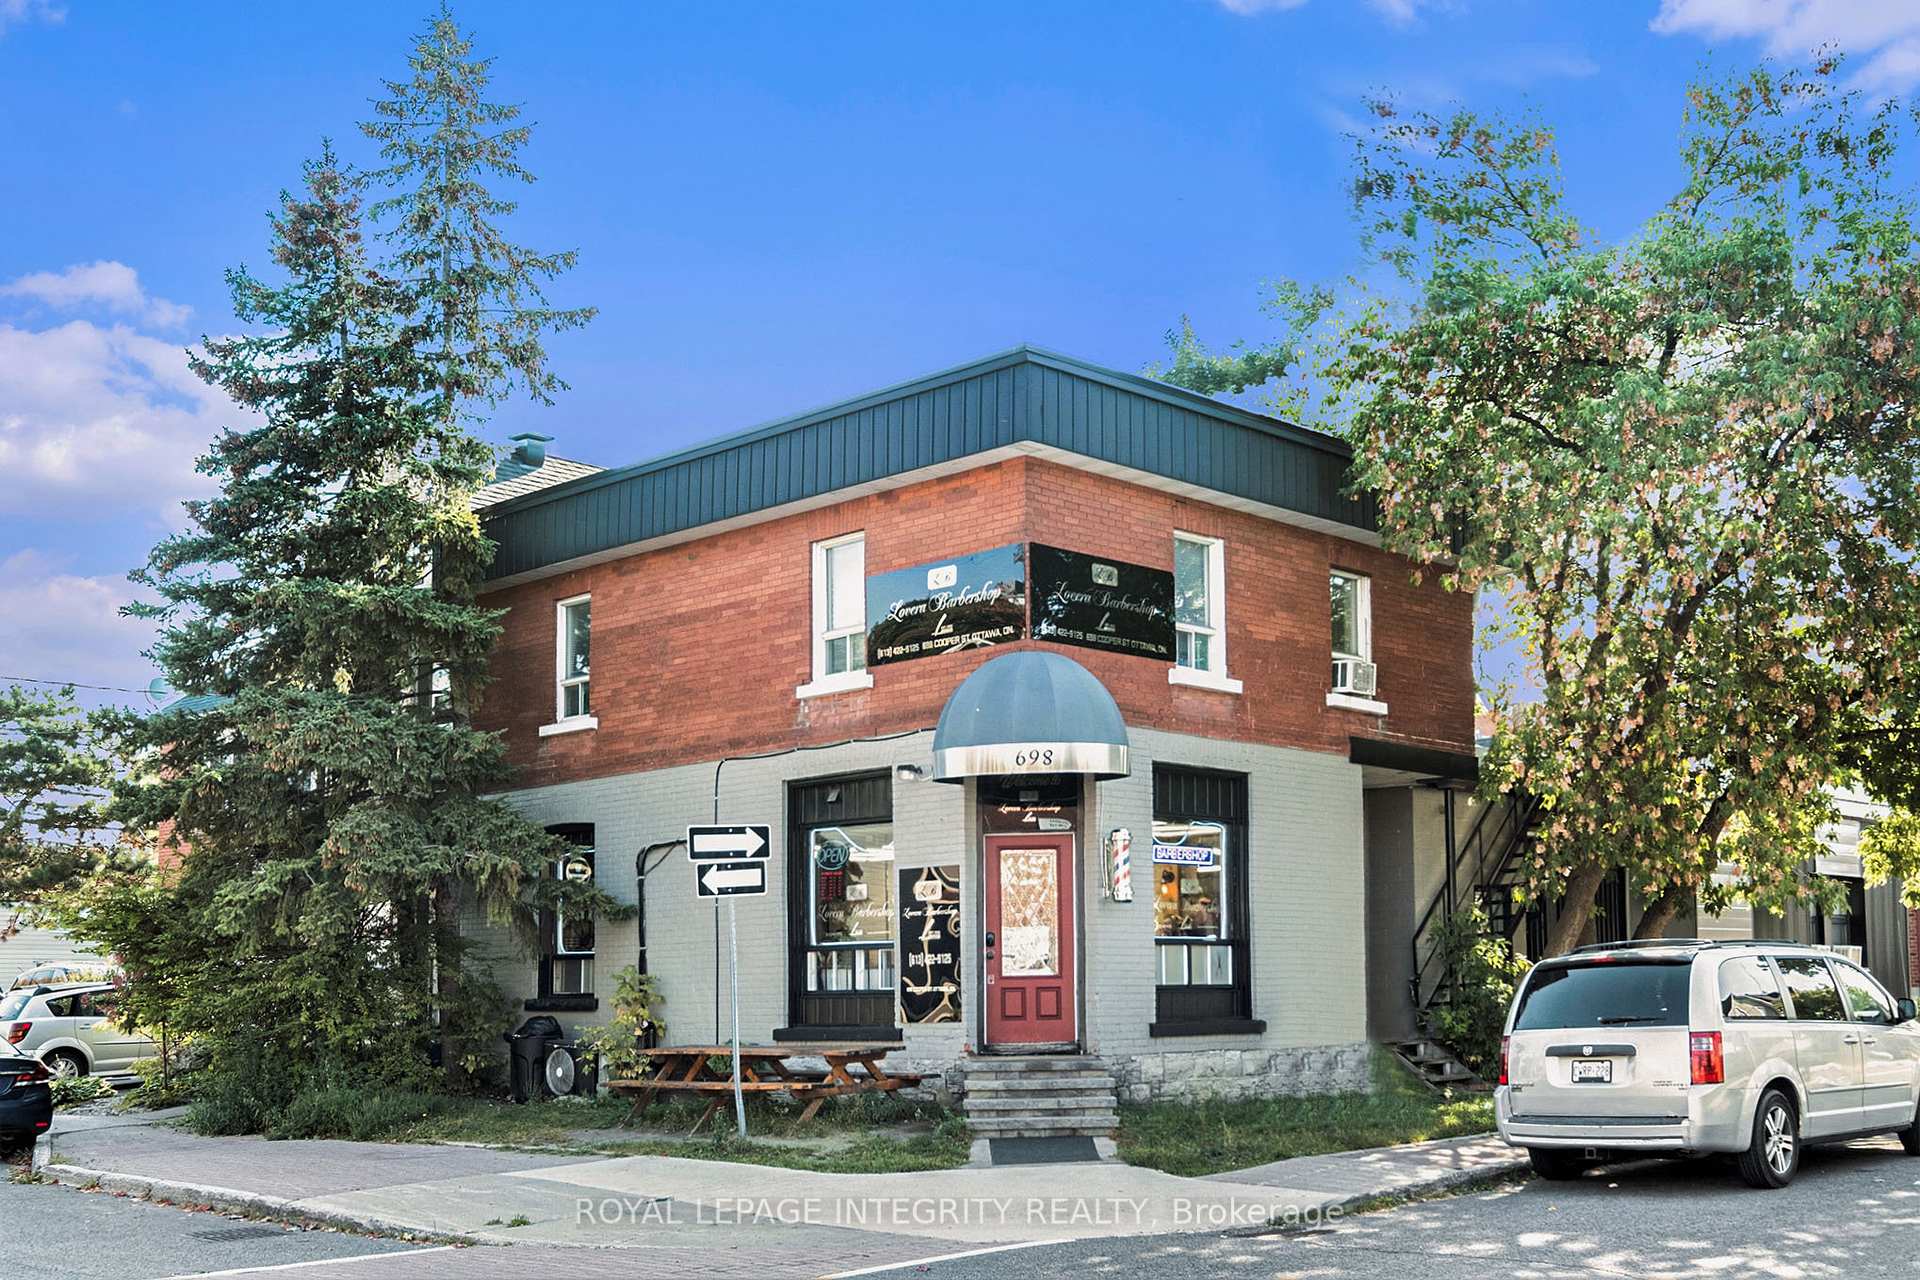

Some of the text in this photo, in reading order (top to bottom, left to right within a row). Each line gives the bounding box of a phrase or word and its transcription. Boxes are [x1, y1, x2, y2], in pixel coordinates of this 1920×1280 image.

[928, 580, 1002, 612] Barbershop
[1093, 589, 1156, 621] Barbershop
[934, 635, 960, 648] COOPER
[1015, 749, 1053, 766] 698
[819, 847, 846, 862] OPEN
[1157, 847, 1208, 861] BARBERSHOP
